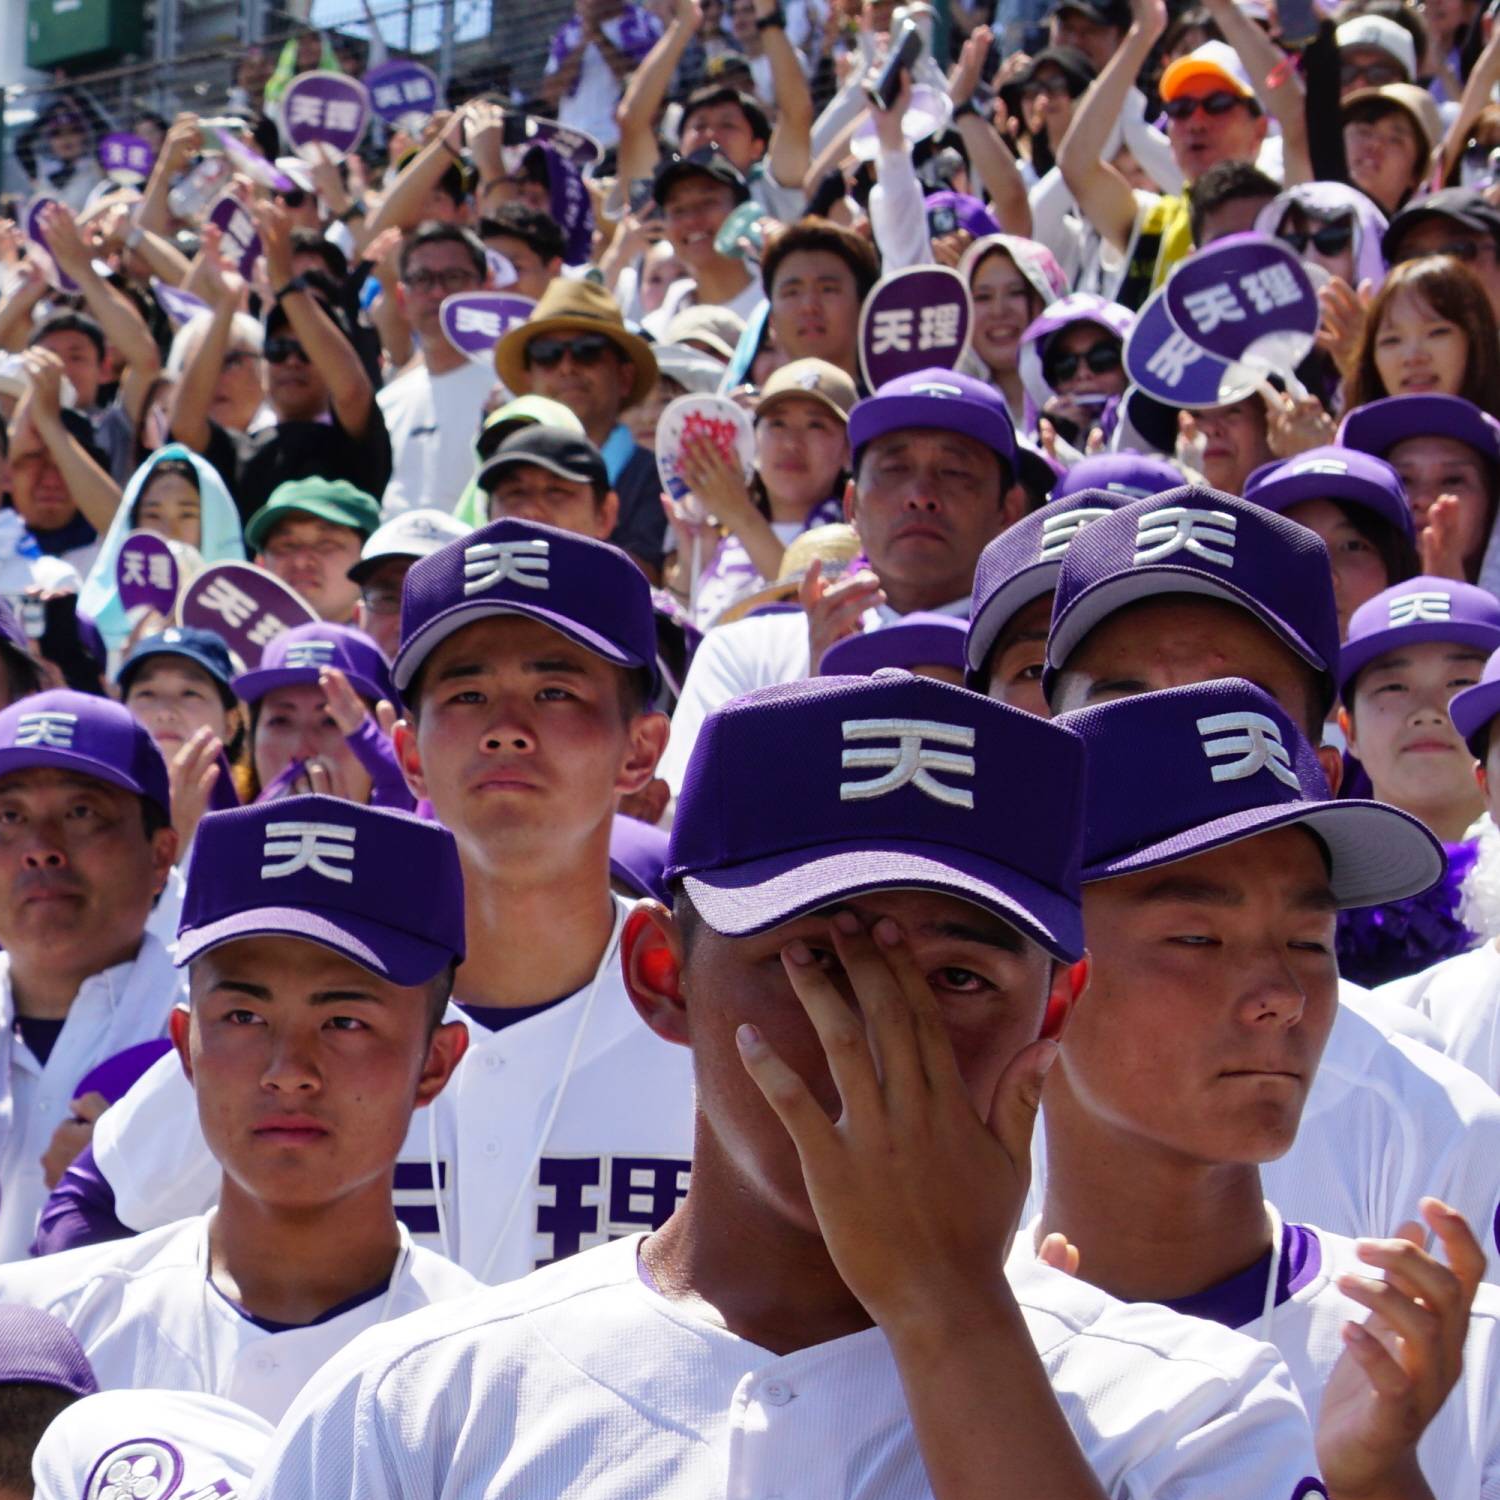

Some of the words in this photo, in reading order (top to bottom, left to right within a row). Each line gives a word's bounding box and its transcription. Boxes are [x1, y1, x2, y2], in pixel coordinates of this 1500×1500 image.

[1183, 262, 1303, 333] 天理
[871, 302, 961, 354] 天理
[1133, 506, 1238, 569] 天
[122, 551, 174, 591] 天理
[464, 540, 549, 596] 天
[1386, 591, 1453, 628] 天
[15, 711, 79, 749] 天
[1195, 711, 1302, 793] 天
[839, 717, 976, 810] 天
[260, 821, 357, 884] 天
